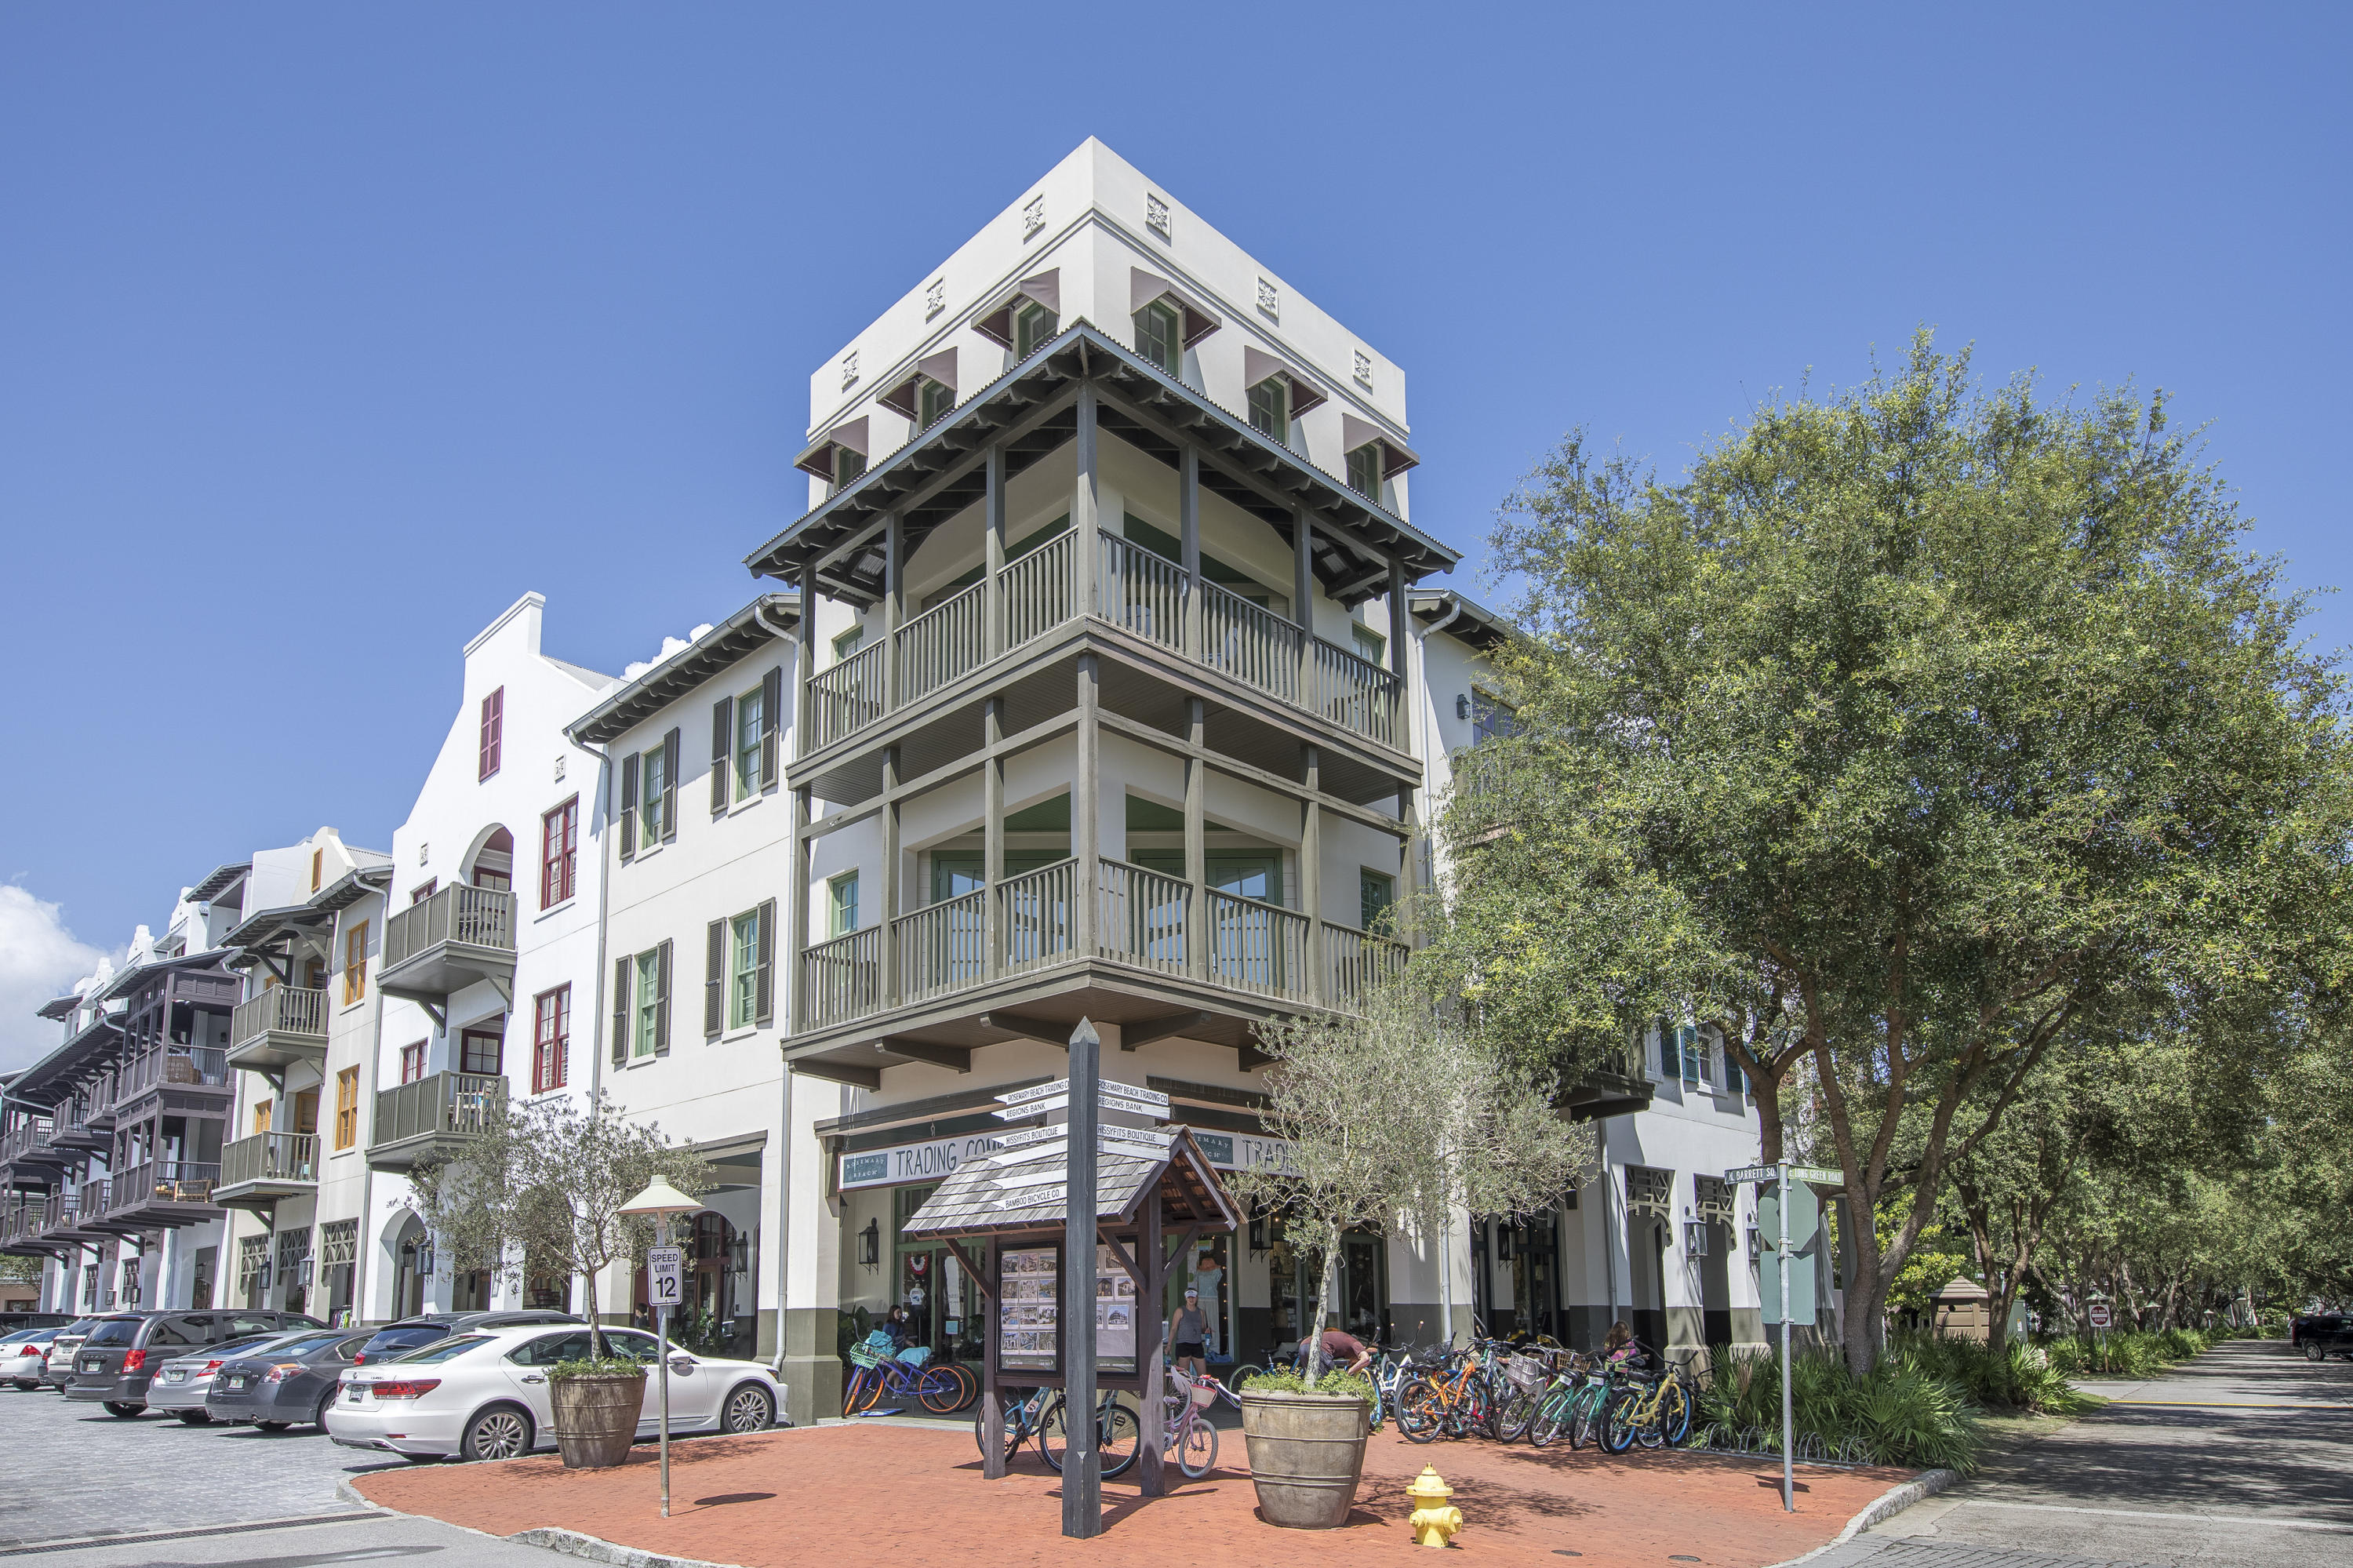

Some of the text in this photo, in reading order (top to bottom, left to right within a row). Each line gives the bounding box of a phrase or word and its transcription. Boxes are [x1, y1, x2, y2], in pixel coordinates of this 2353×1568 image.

[1008, 1090, 1030, 1102] ROSEMARY
[1030, 1087, 1044, 1097] BEACH
[1045, 1082, 1064, 1094] TRADING
[1098, 1081, 1167, 1103] ROSEMARY BEACH TRADING CO
[1007, 1102, 1046, 1118] REGIONS BANK
[1098, 1097, 1142, 1112] REGIONS BANK
[1006, 1127, 1058, 1145] HISSYFITS BOUTIQUE
[1098, 1126, 1156, 1142] HISSYFITS BOUTIQUE
[847, 1158, 884, 1169] ROSEMARY
[896, 1142, 957, 1176] TRADING
[1736, 1168, 1763, 1180] BARRETT
[1795, 1167, 1808, 1178] LONG
[1810, 1170, 1826, 1180] GREEN
[1828, 1171, 1842, 1182] ROAD
[1006, 1197, 1026, 1208] BAMBOO
[1028, 1191, 1050, 1204] BICYCLE
[652, 1254, 678, 1262] SPEED
[655, 1264, 675, 1273] LIMIT
[656, 1277, 676, 1298] 12
